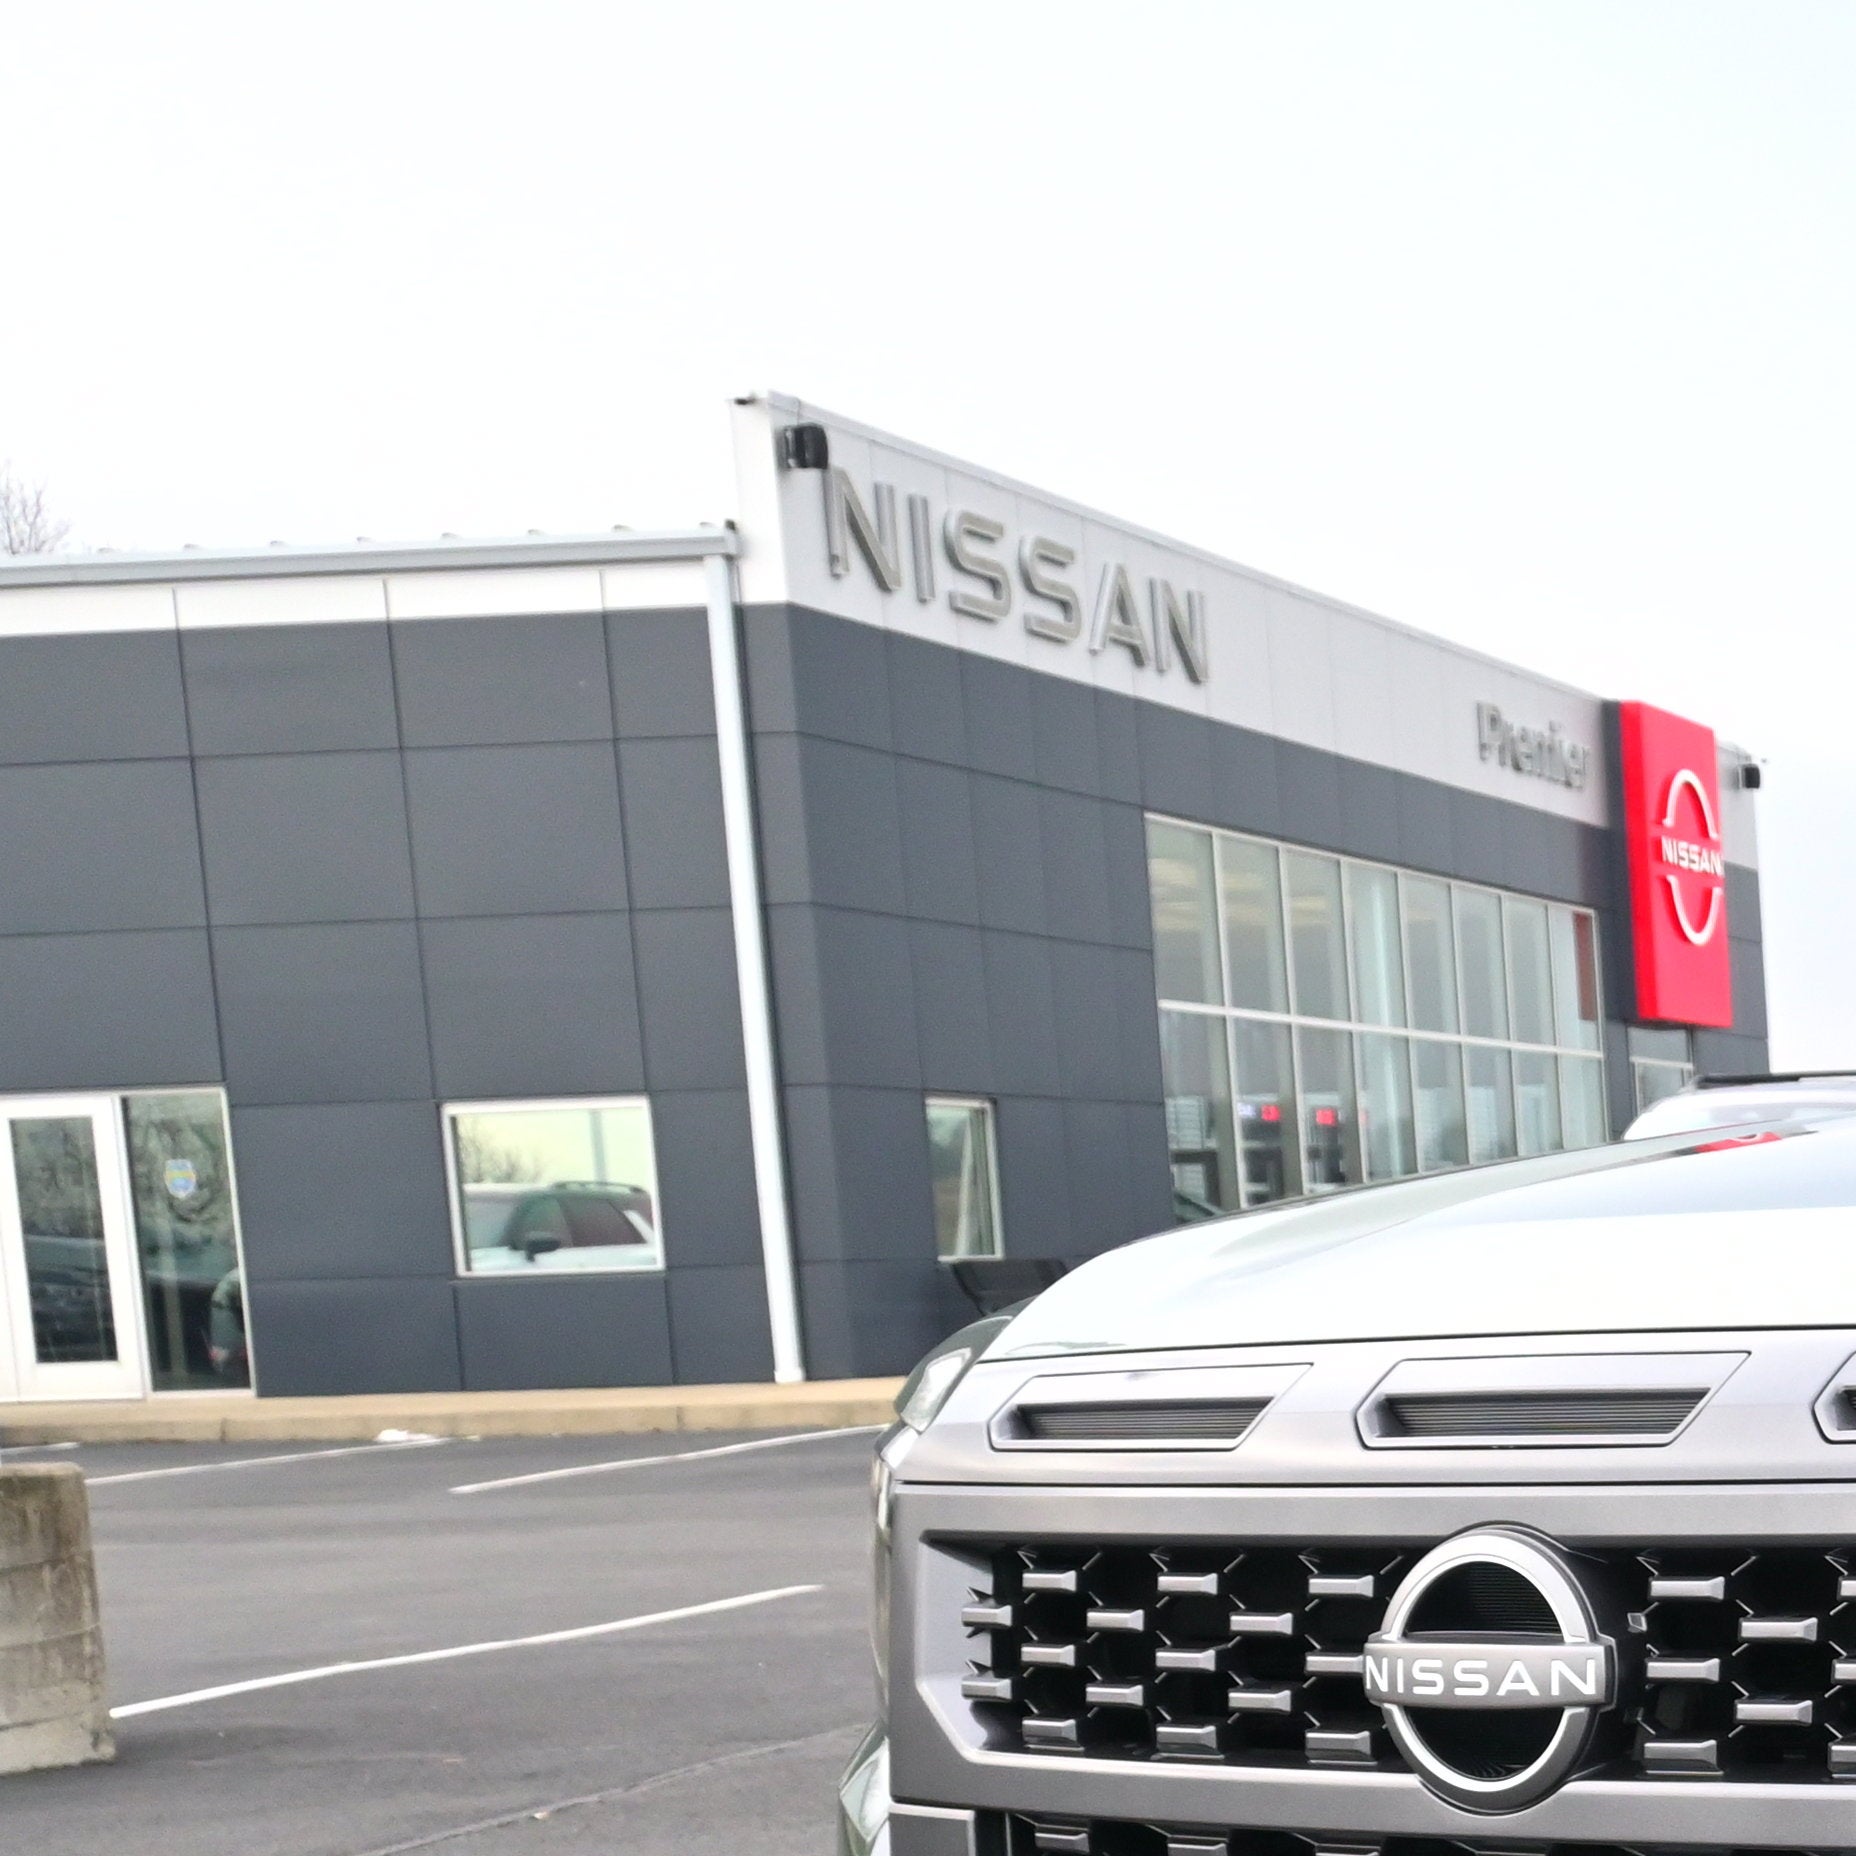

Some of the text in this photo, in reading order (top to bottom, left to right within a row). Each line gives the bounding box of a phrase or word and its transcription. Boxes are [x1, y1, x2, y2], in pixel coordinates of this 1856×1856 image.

[821, 465, 1210, 685] NISSAN
[1477, 702, 1593, 790] Premier
[1661, 836, 1724, 878] NISSAN
[1365, 1656, 1596, 1696] NISSAN
